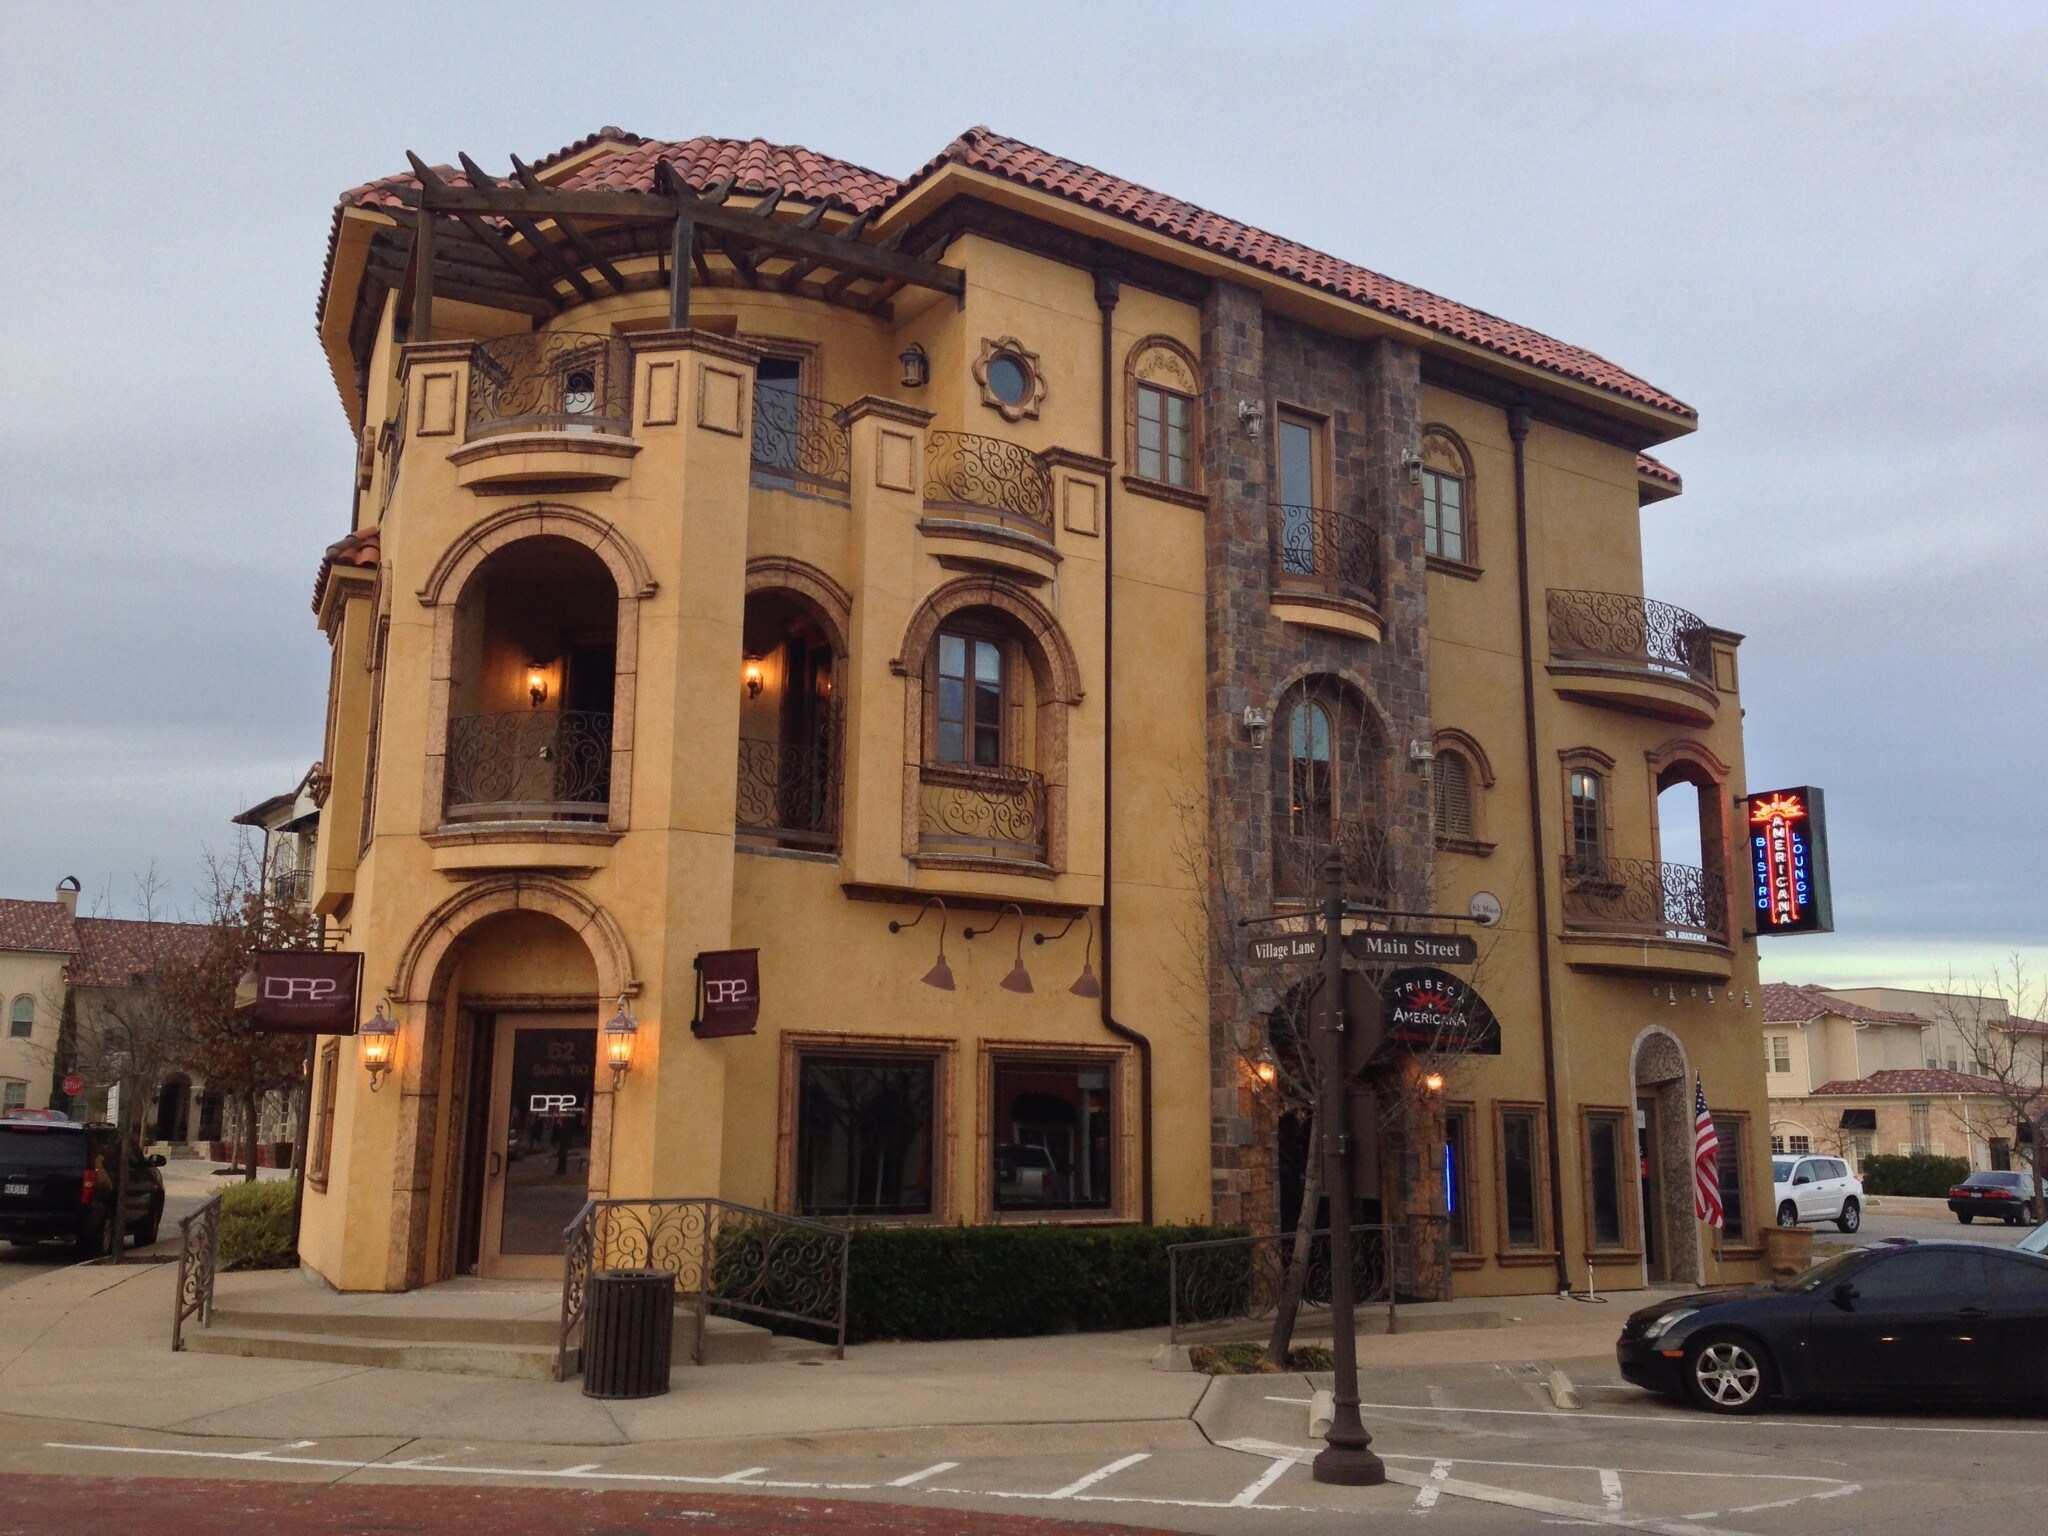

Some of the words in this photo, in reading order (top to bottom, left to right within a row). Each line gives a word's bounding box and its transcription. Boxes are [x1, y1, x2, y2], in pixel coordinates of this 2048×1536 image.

[1756, 837, 1768, 908] BISTRO
[1772, 816, 1791, 924] AMERICANA
[1792, 832, 1807, 904] LOUNGE
[1255, 942, 1289, 960] Village
[1291, 940, 1316, 956] Lane
[1366, 937, 1408, 955] Main
[1414, 940, 1460, 957] Street
[547, 1042, 575, 1060] 62
[532, 1064, 564, 1076] Suite
[569, 1064, 588, 1076] 110
[65, 1081, 82, 1089] STOP
